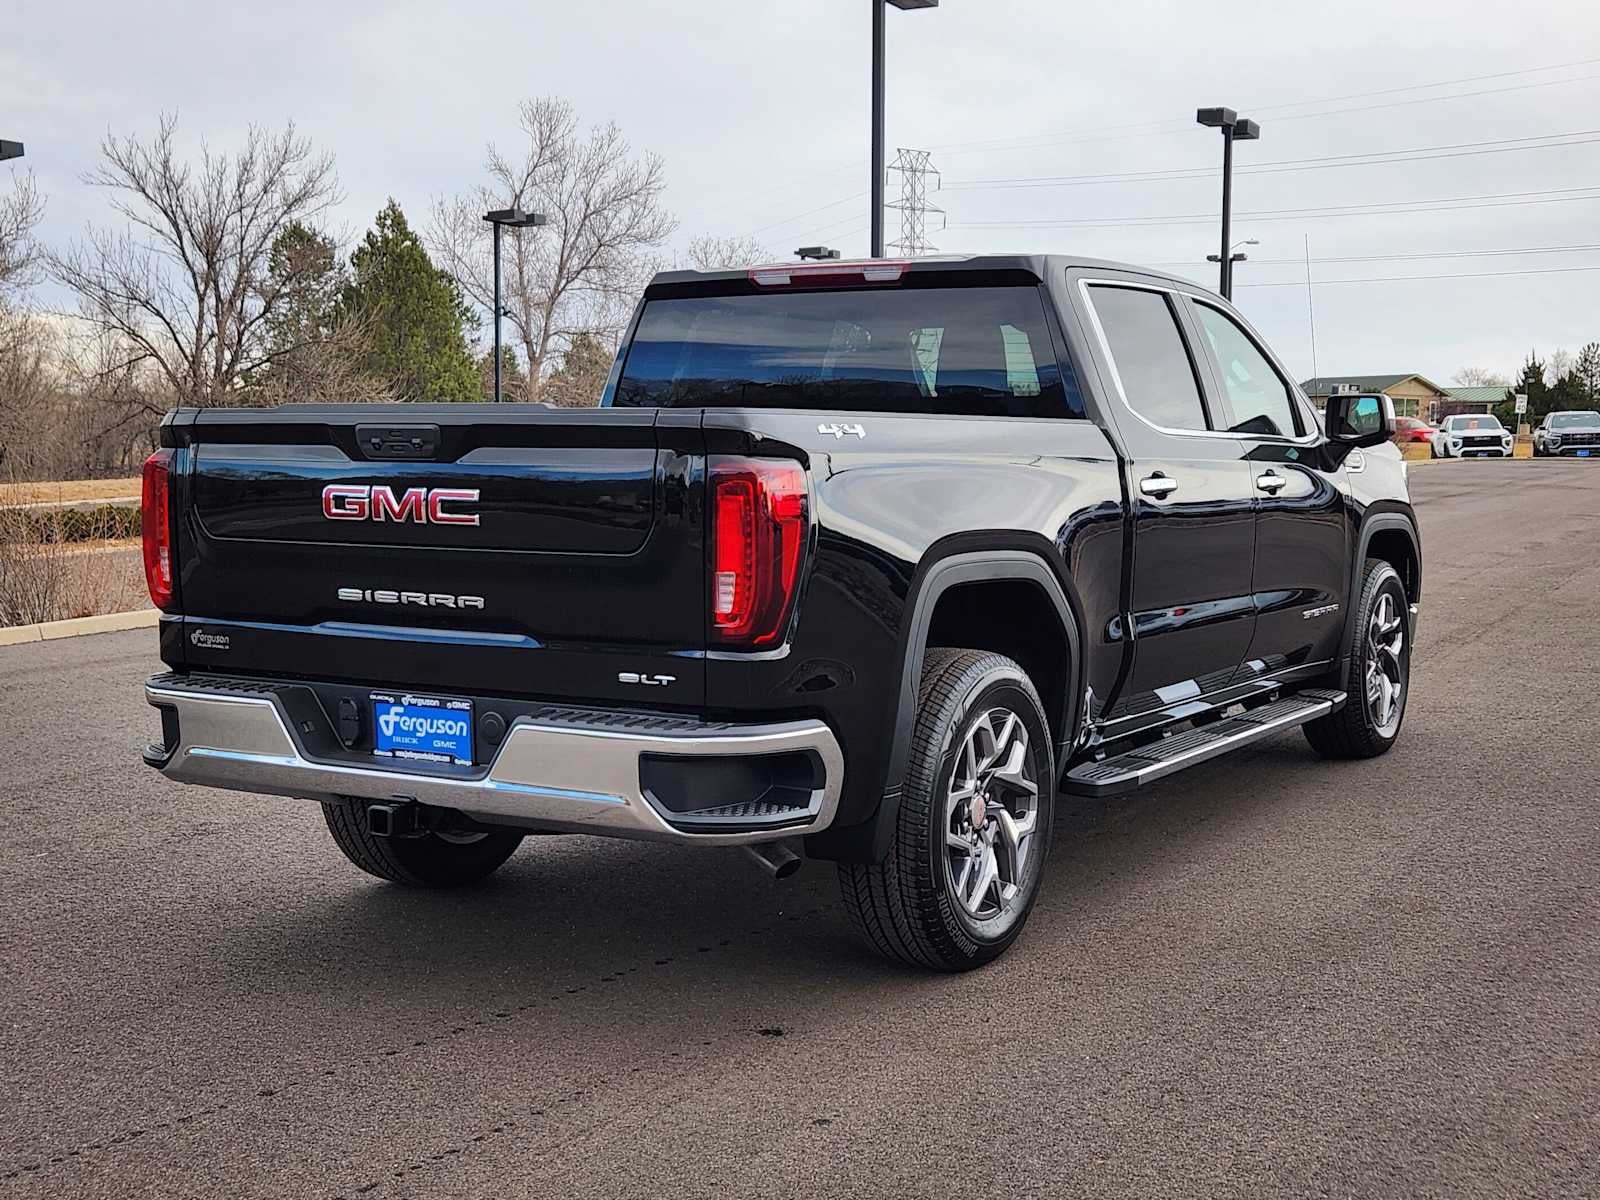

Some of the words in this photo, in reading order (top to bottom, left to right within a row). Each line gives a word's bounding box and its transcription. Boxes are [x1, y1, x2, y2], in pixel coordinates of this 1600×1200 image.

[322, 484, 480, 526] GMC
[337, 588, 485, 609] SIERRA
[190, 629, 230, 645] Ferguson
[618, 672, 677, 686] SLT
[401, 694, 440, 707] Ferguson
[452, 701, 471, 710] GMC
[379, 706, 467, 737] Ferguson
[432, 740, 457, 749] GMC
